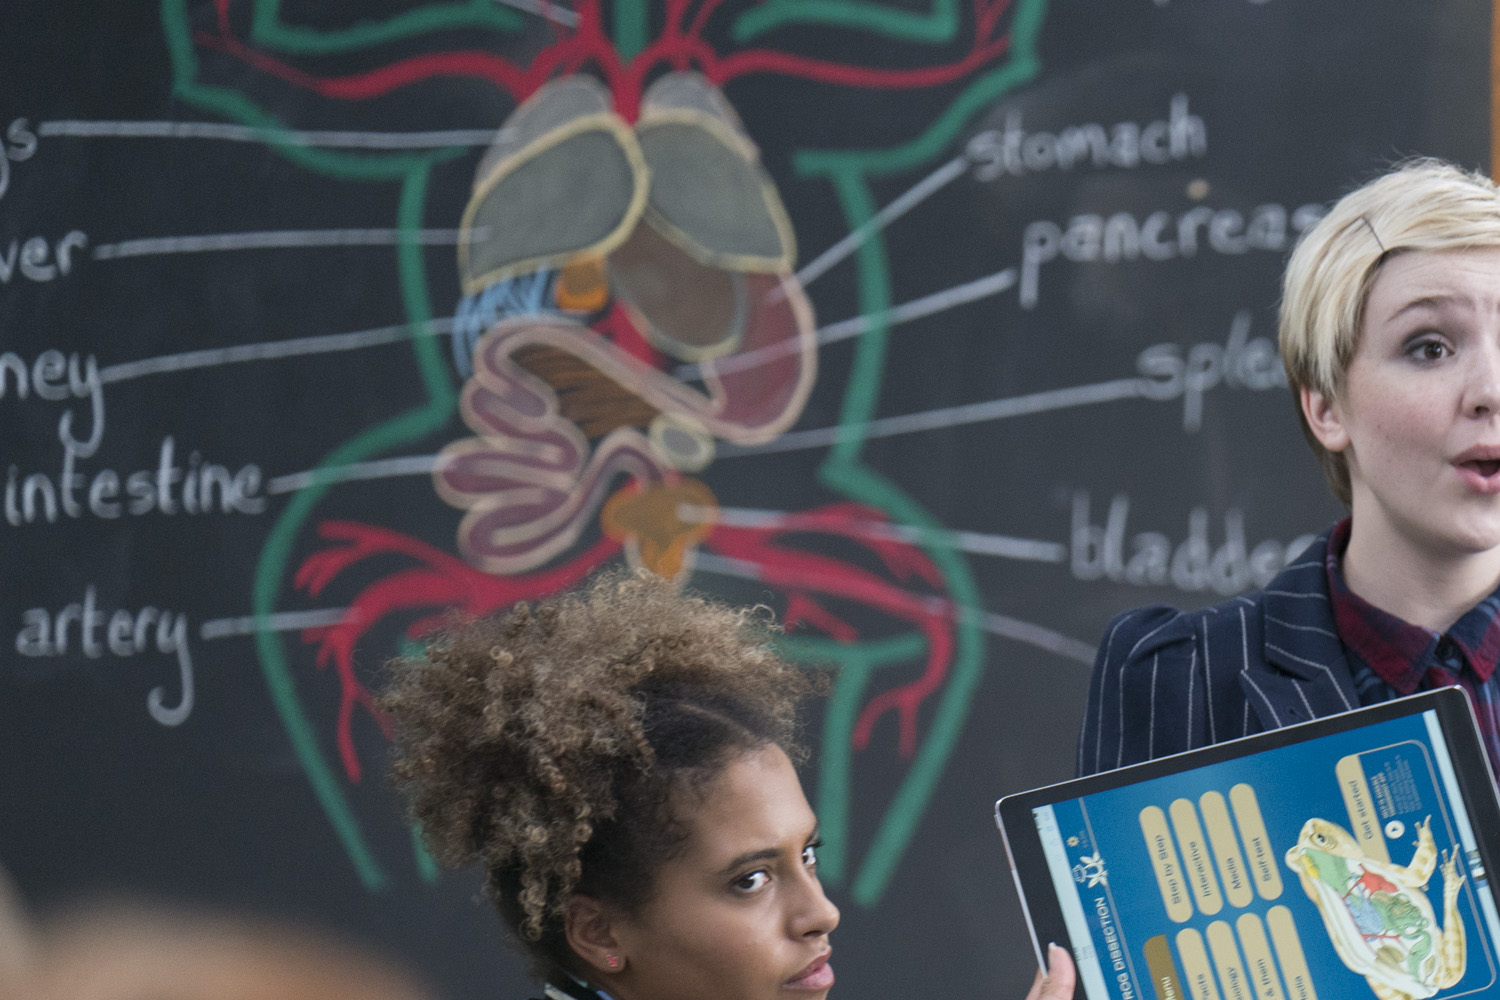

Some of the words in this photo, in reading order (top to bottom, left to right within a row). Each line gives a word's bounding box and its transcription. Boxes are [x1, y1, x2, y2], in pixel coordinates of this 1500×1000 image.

[965, 92, 1207, 181] stomach
[1136, 308, 1289, 433] sple
[4, 435, 267, 526] intestine
[15, 585, 194, 726] artery
[1348, 779, 1367, 819] started
[1154, 834, 1169, 861] Step
[1361, 820, 1374, 841] Get
[1163, 862, 1175, 878] by
[1189, 840, 1213, 898] Interactive
[1226, 856, 1242, 890] Media
[1251, 836, 1273, 883] Self-test
[1167, 877, 1182, 905] Step
[1094, 896, 1127, 972] DISSECTION
[1256, 957, 1272, 986] them
[1264, 987, 1275, 998] &
